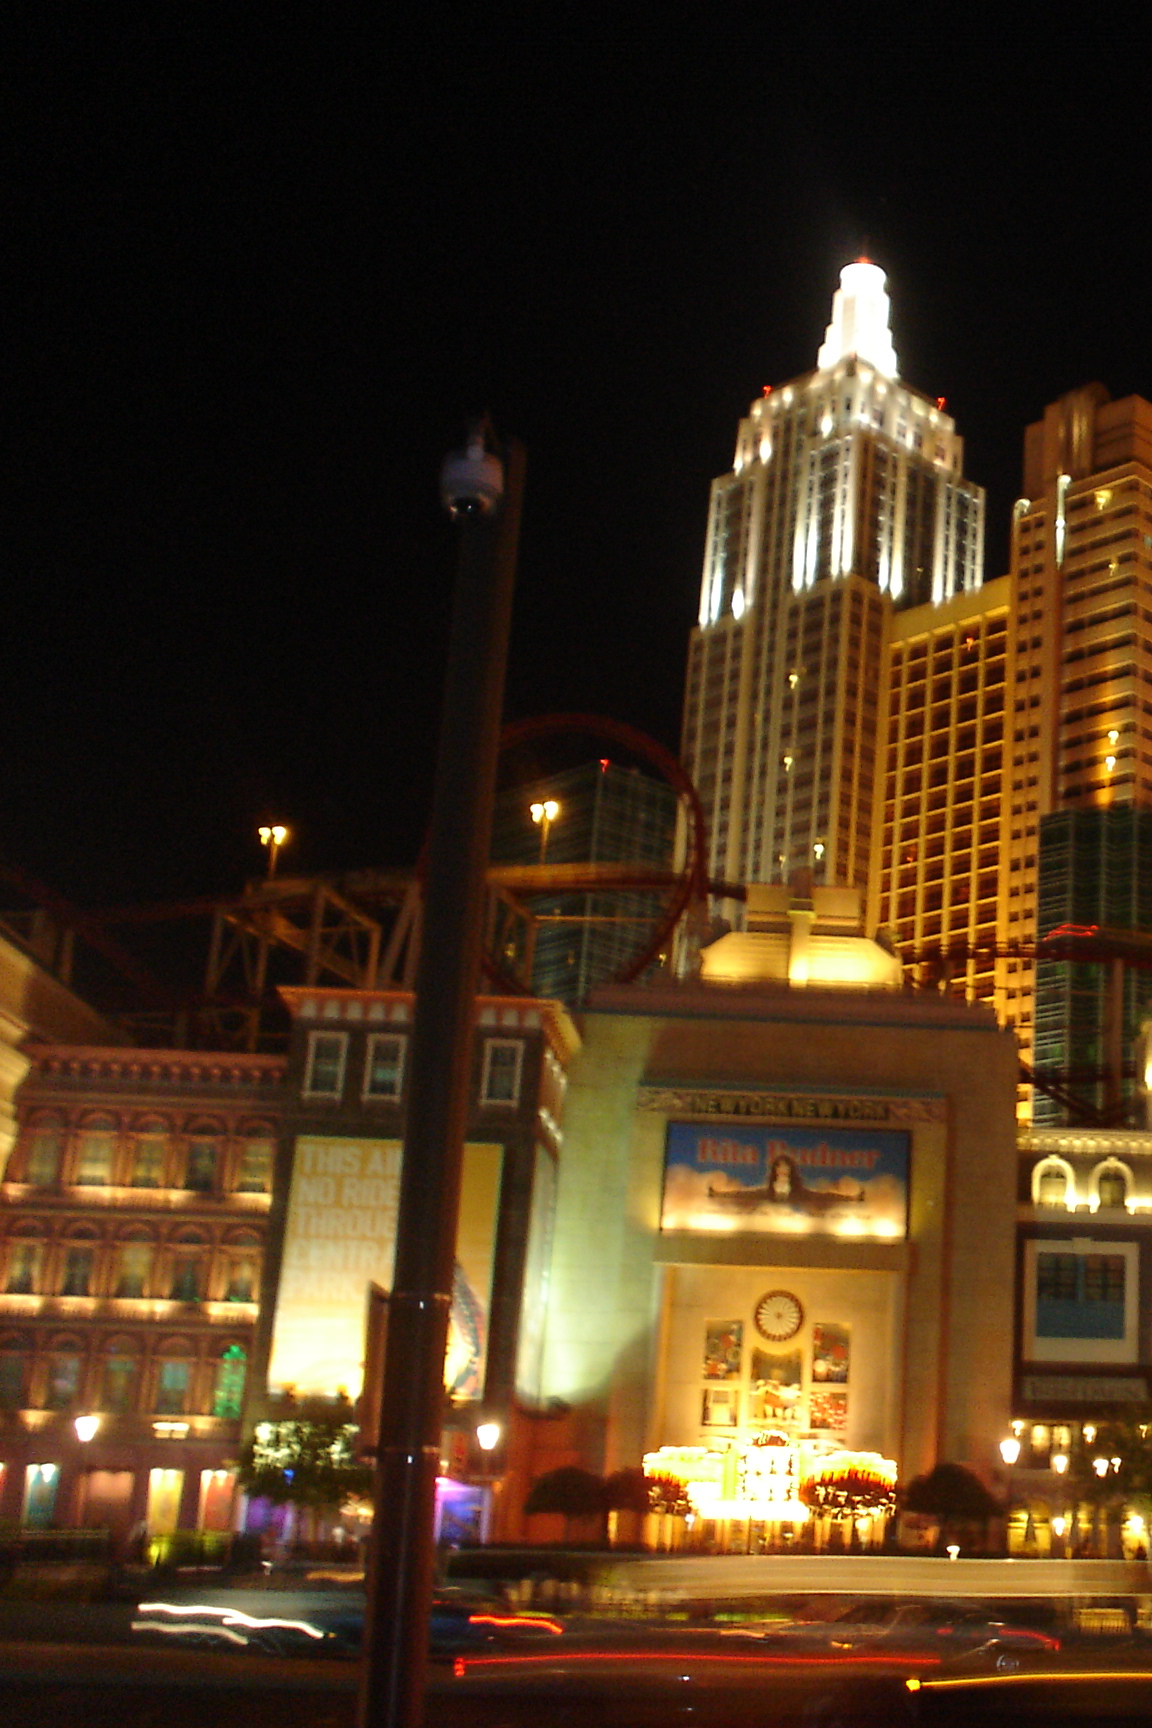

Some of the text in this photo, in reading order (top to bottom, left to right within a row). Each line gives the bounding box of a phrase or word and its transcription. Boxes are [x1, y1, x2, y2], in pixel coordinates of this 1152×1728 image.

[301, 1145, 361, 1174] THIS
[697, 1137, 759, 1164] Rita
[298, 1177, 336, 1204] NO
